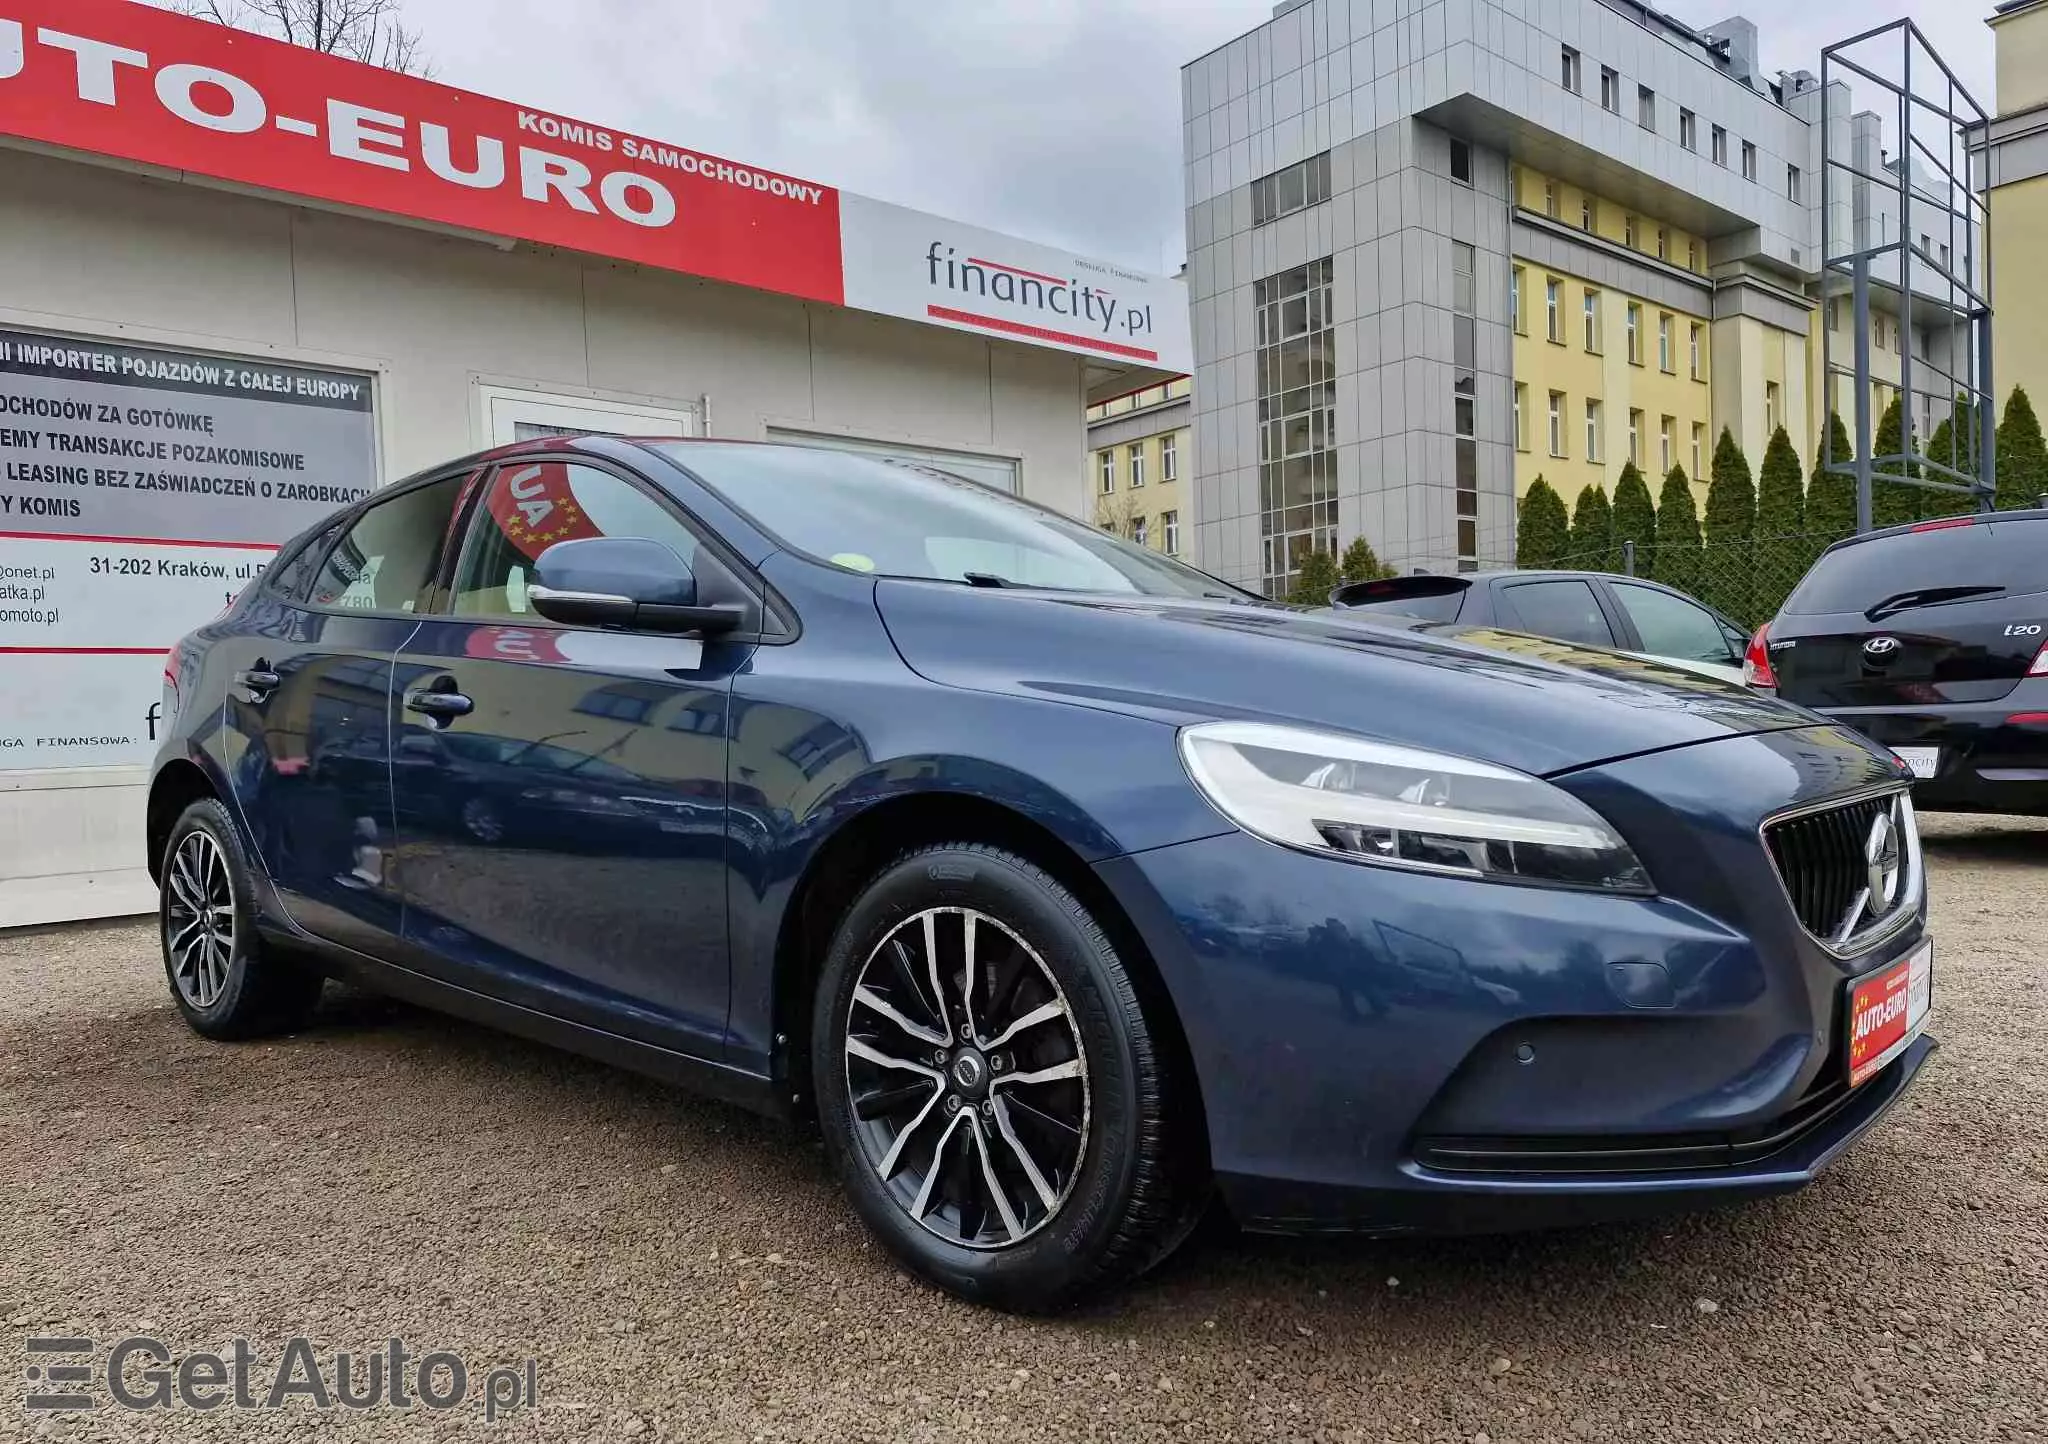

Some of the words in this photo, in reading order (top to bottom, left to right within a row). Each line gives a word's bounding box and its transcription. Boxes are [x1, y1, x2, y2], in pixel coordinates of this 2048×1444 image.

[0, 18, 676, 227] TO-EURO
[518, 111, 613, 151] KOMIS
[622, 138, 823, 205] SAMOCHODOWY
[926, 241, 1152, 336] financity.pl
[17, 344, 117, 374] IMPORTER
[121, 356, 219, 385] POJAZDÓW
[224, 369, 235, 387] Z
[240, 371, 292, 393] CAŁEJ
[296, 378, 360, 400] EUROPY
[97, 405, 122, 424] ZA
[127, 407, 214, 437] GOTÓWKĘ
[46, 432, 167, 459] TRANSAKCJE
[172, 443, 304, 470] POZAKOMISOWE
[7, 462, 89, 486] LEASING
[94, 469, 130, 488] BEZ
[134, 469, 255, 497] ZAŚWIADCZEŃ
[261, 481, 272, 498] O
[20, 497, 81, 517] KOMIS
[90, 557, 151, 575] 31-202
[158, 560, 229, 580] Kraków,
[37, 735, 137, 747] FINANSOWA:
[1857, 990, 1906, 1040] AUTO-EURO
